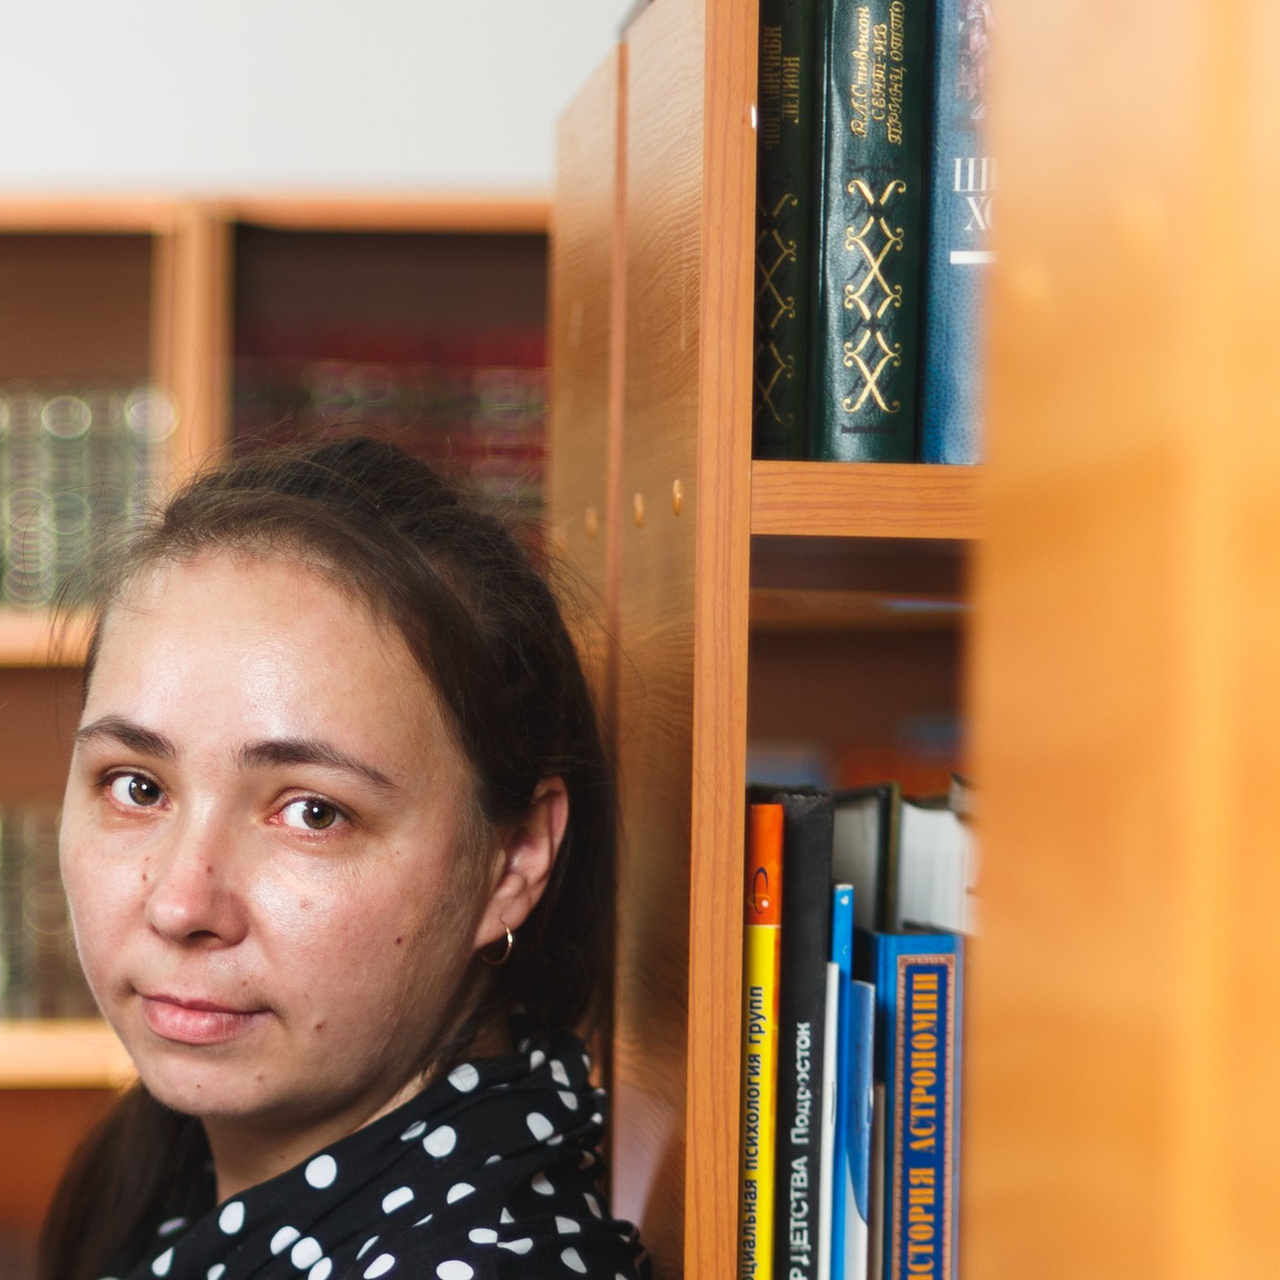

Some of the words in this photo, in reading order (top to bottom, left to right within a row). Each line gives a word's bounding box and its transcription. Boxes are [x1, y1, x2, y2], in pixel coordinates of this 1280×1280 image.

[871, 23, 888, 121] СЕНТ-ИВ
[888, 0, 906, 62] ОТТО
[781, 56, 800, 124] ЛЕГИОН
[887, 65, 908, 145] ПРИНЦ
[748, 985, 767, 1045] групп
[909, 972, 939, 1155] АСТРОНОМИИ
[743, 1052, 762, 1171] психология
[790, 1022, 812, 1146] Подросток
[789, 1156, 812, 1266] ДЕТСТВА
